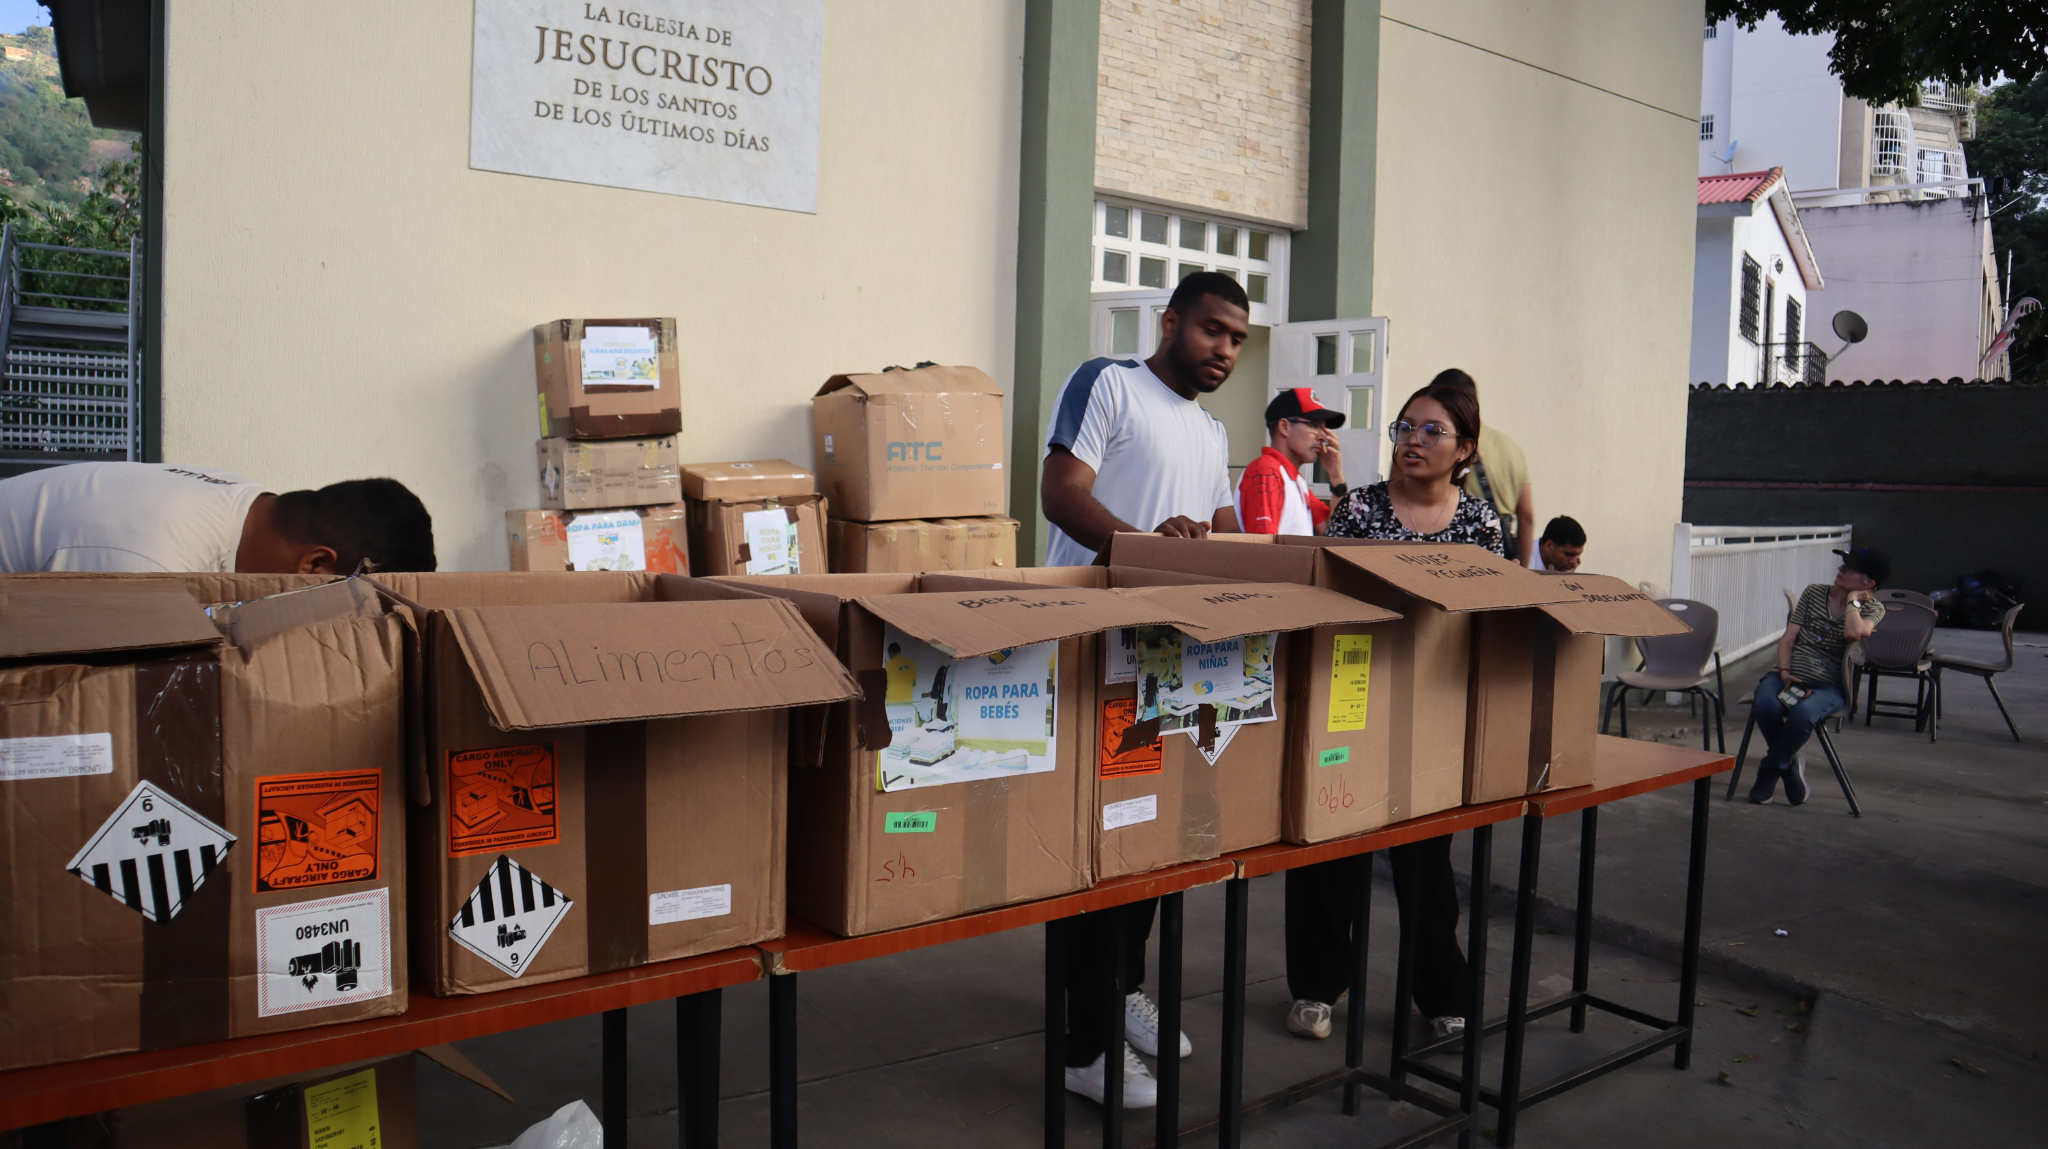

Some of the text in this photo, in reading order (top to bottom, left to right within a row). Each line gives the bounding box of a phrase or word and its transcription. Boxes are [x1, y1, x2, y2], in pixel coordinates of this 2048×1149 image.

[584, 3, 733, 47] LA IGLESIA DE
[534, 25, 773, 96] JESUCRISTO
[573, 78, 737, 121] DE LOS SANTOS
[534, 100, 770, 153] DE LOS ÚLTIMOS DÍAS
[887, 441, 943, 462] ATC
[886, 463, 992, 472] Atlantic Thermal Components
[567, 525, 590, 533] ROPA
[592, 522, 615, 531] PARA
[759, 528, 781, 536] ROPA
[761, 536, 781, 544] PARA
[972, 533, 987, 541] Press
[1426, 565, 1504, 579] PEQUEÑA
[1187, 641, 1239, 657] ROPA PARA
[1198, 655, 1229, 670] NIÑAS
[965, 683, 1040, 701] ROPA PARA
[980, 701, 1020, 719] BEBÉS
[887, 717, 913, 725] ACIONES
[455, 747, 541, 763] CARGO AIRCRAFT
[484, 758, 514, 770] ONLY
[264, 784, 295, 793] AIRCRAFT
[296, 782, 333, 790] PASSENGER
[342, 778, 377, 787] FORBIDDEN
[142, 798, 154, 812] 9
[453, 839, 485, 848] FORBIDDEN
[493, 833, 525, 843] PASSENGER
[526, 830, 553, 839] AIRCRAFT
[305, 861, 339, 873] ONLY
[272, 867, 370, 887] CARGO AIRCRAFT
[295, 918, 350, 941] UN3480
[510, 952, 519, 965] 9
